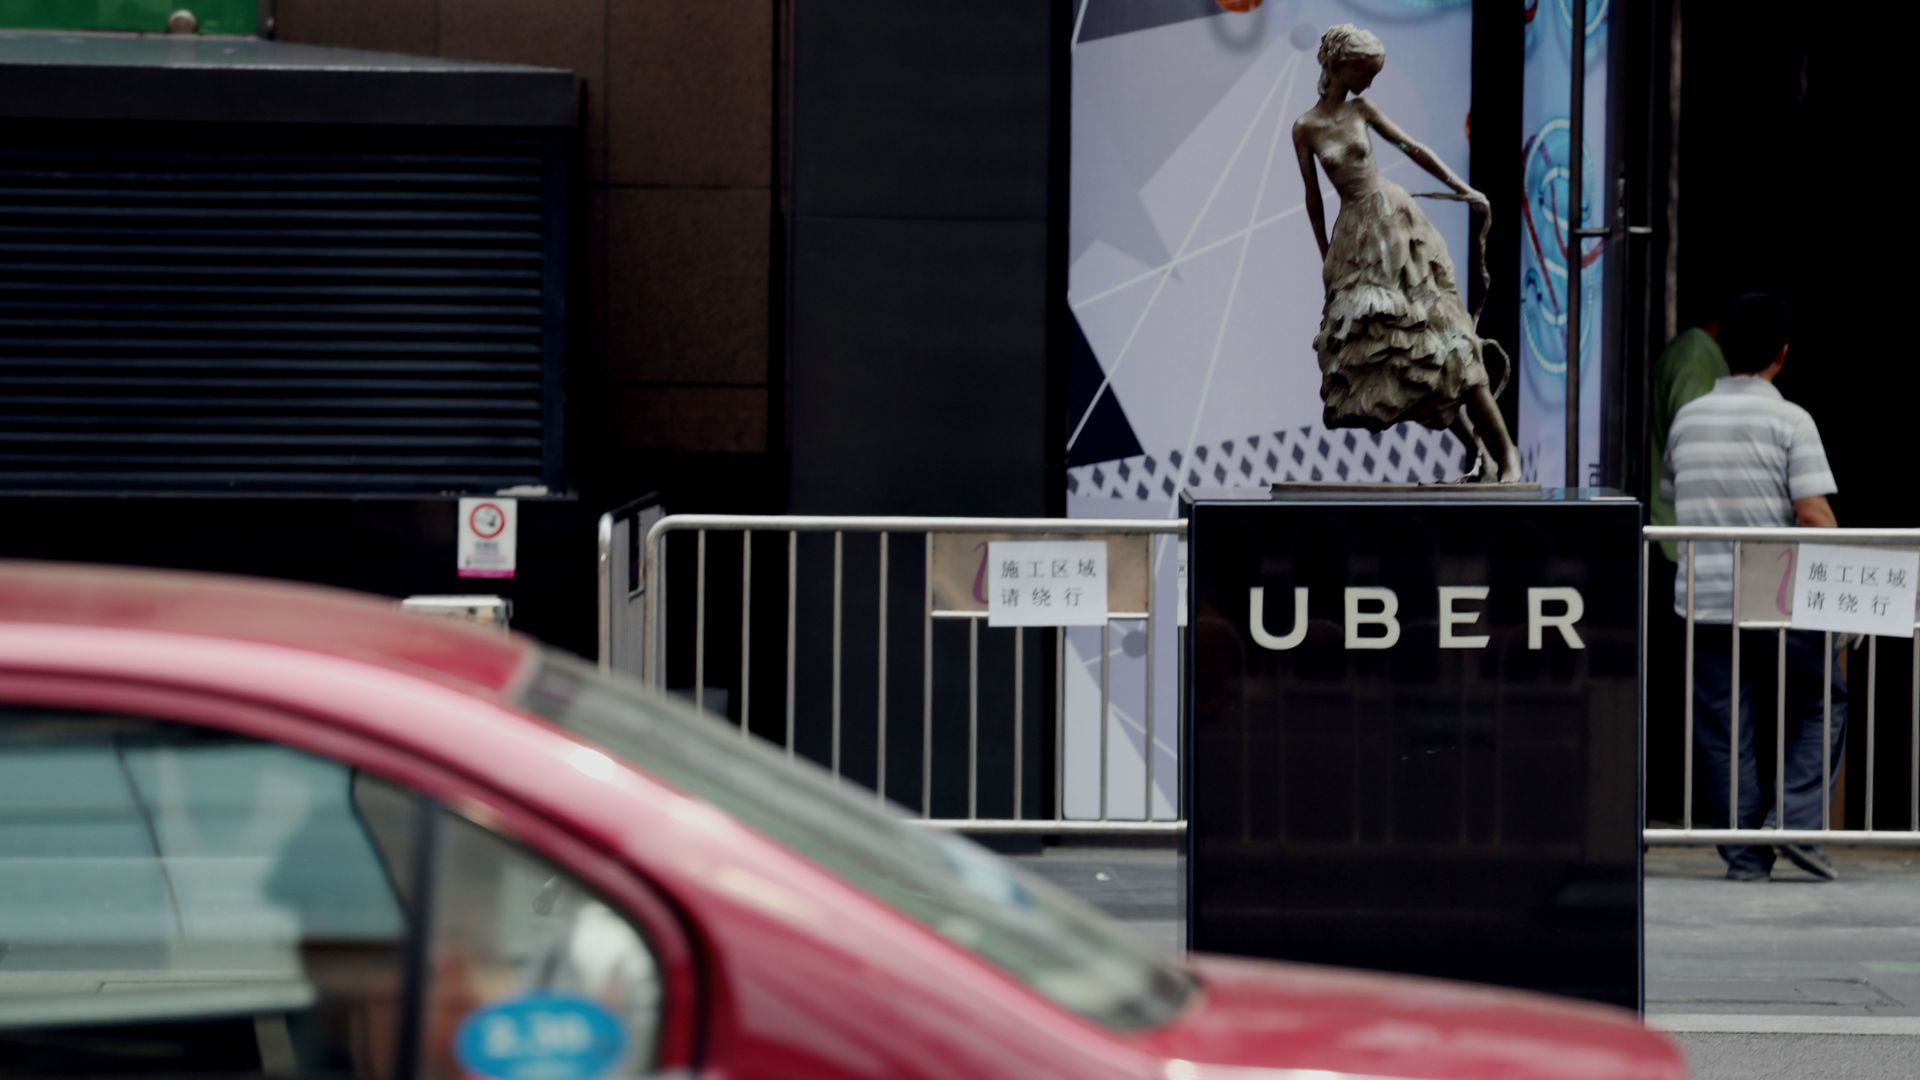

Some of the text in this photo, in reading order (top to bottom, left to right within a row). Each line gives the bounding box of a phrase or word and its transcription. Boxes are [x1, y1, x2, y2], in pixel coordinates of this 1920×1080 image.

[1001, 559, 1096, 579] 施工区域
[1808, 562, 1907, 588] 施工区域
[1001, 588, 1083, 607] 请绕行
[1807, 592, 1890, 616] 请绕行
[1249, 586, 1586, 650] UBER
